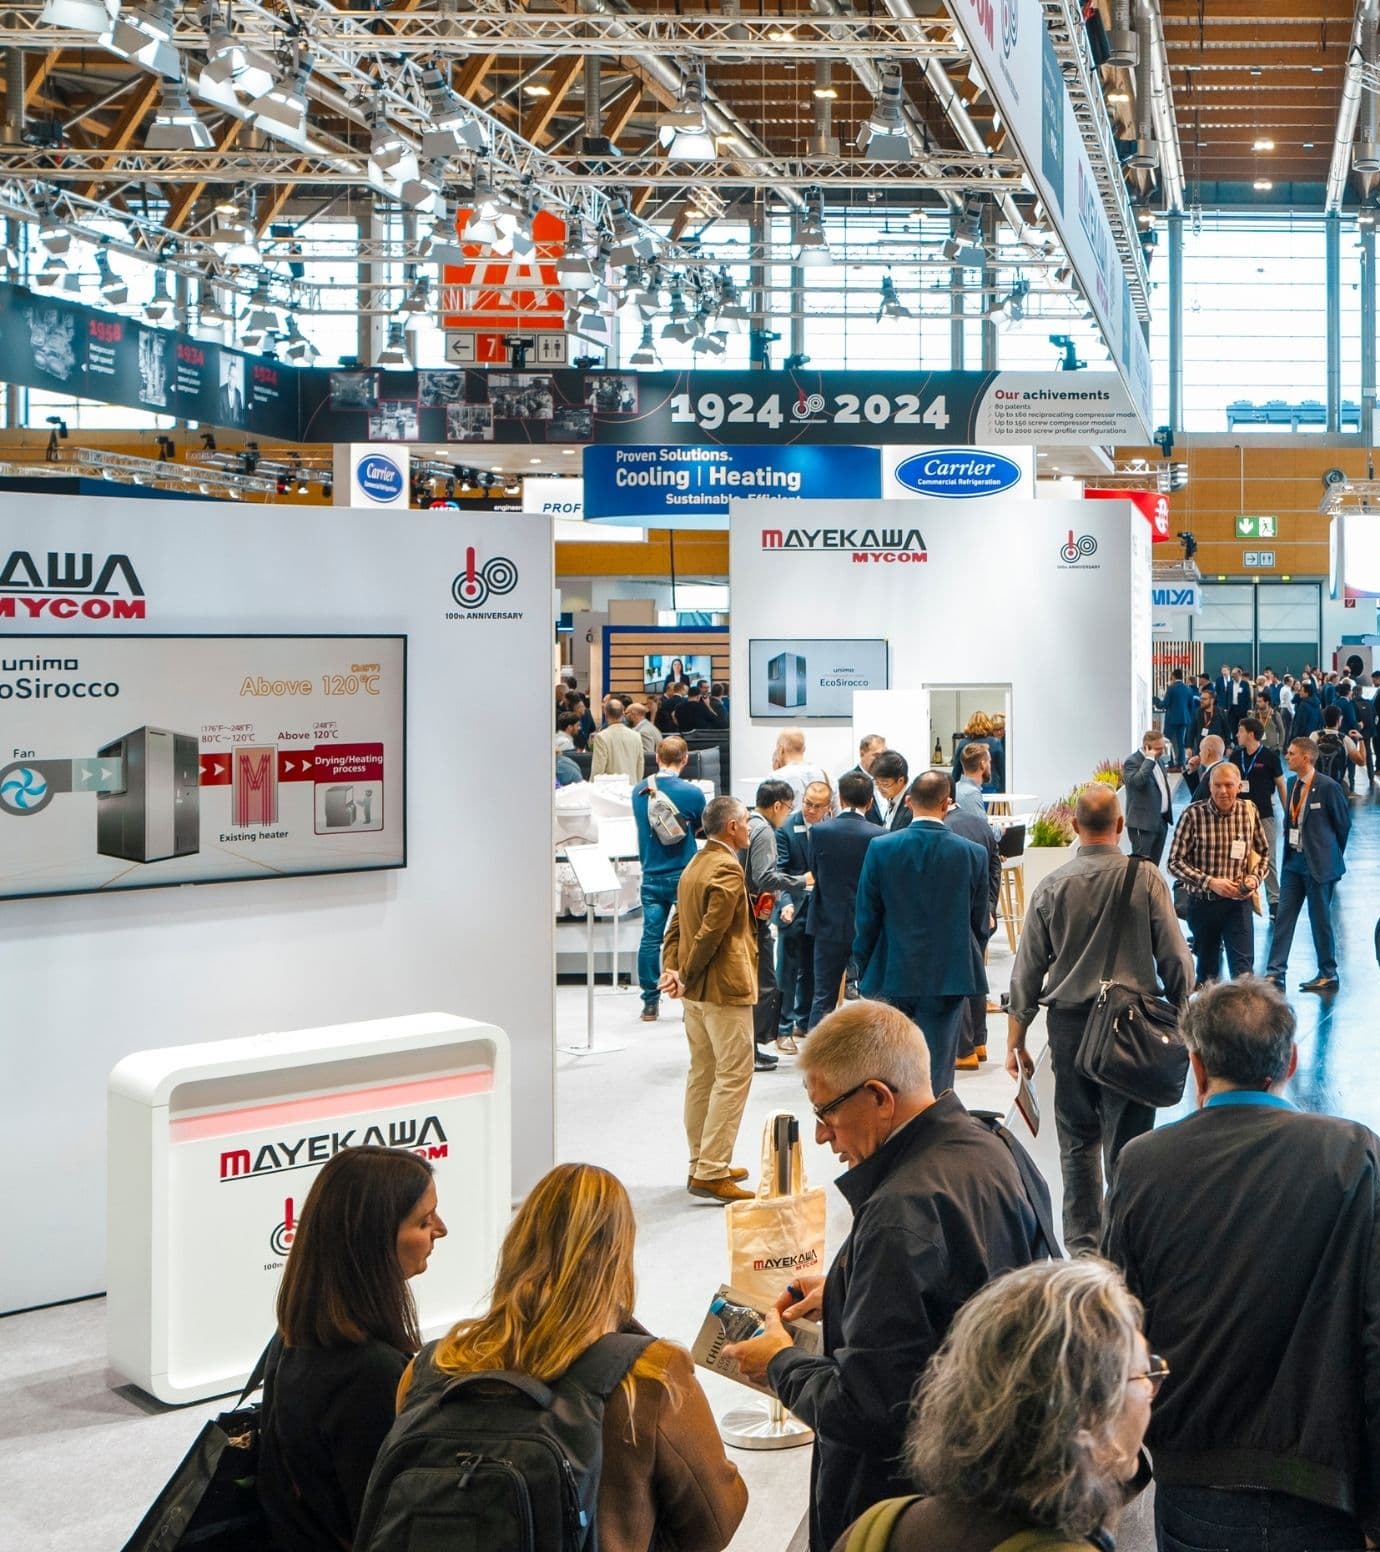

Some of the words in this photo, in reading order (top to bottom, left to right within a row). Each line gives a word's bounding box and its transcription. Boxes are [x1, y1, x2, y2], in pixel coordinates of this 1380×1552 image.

[487, 338, 497, 357] 7
[995, 389, 1019, 400] Our
[1023, 388, 1110, 400] achivements
[671, 394, 784, 430] 1924
[834, 394, 950, 430] 2024
[1005, 403, 1031, 411] patents
[995, 412, 1005, 420] Up
[1028, 411, 1074, 420] reciprocating
[1075, 412, 1115, 420] compressor
[1078, 427, 1127, 435] configurations
[616, 450, 657, 463] Proven
[659, 448, 733, 462] Solutions.
[366, 463, 396, 483] Carrier
[924, 459, 996, 476] Carrier
[616, 466, 690, 490] Cooling
[709, 466, 802, 491] Heating
[917, 478, 957, 486] Commercial
[762, 529, 927, 550] MAYEKAWA
[852, 552, 928, 563] MYCOM
[466, 612, 523, 620] ANNIVERSARY
[2, 655, 79, 671] unimo
[240, 676, 313, 696] Above
[820, 678, 870, 687] EcoSirocco
[277, 731, 310, 740] Above
[13, 748, 35, 759] Fan
[315, 755, 384, 766] Drying/Heating
[333, 765, 367, 775] process
[219, 833, 256, 843] Existing
[259, 831, 289, 840] heater
[753, 1249, 818, 1271] MAYEKAWA
